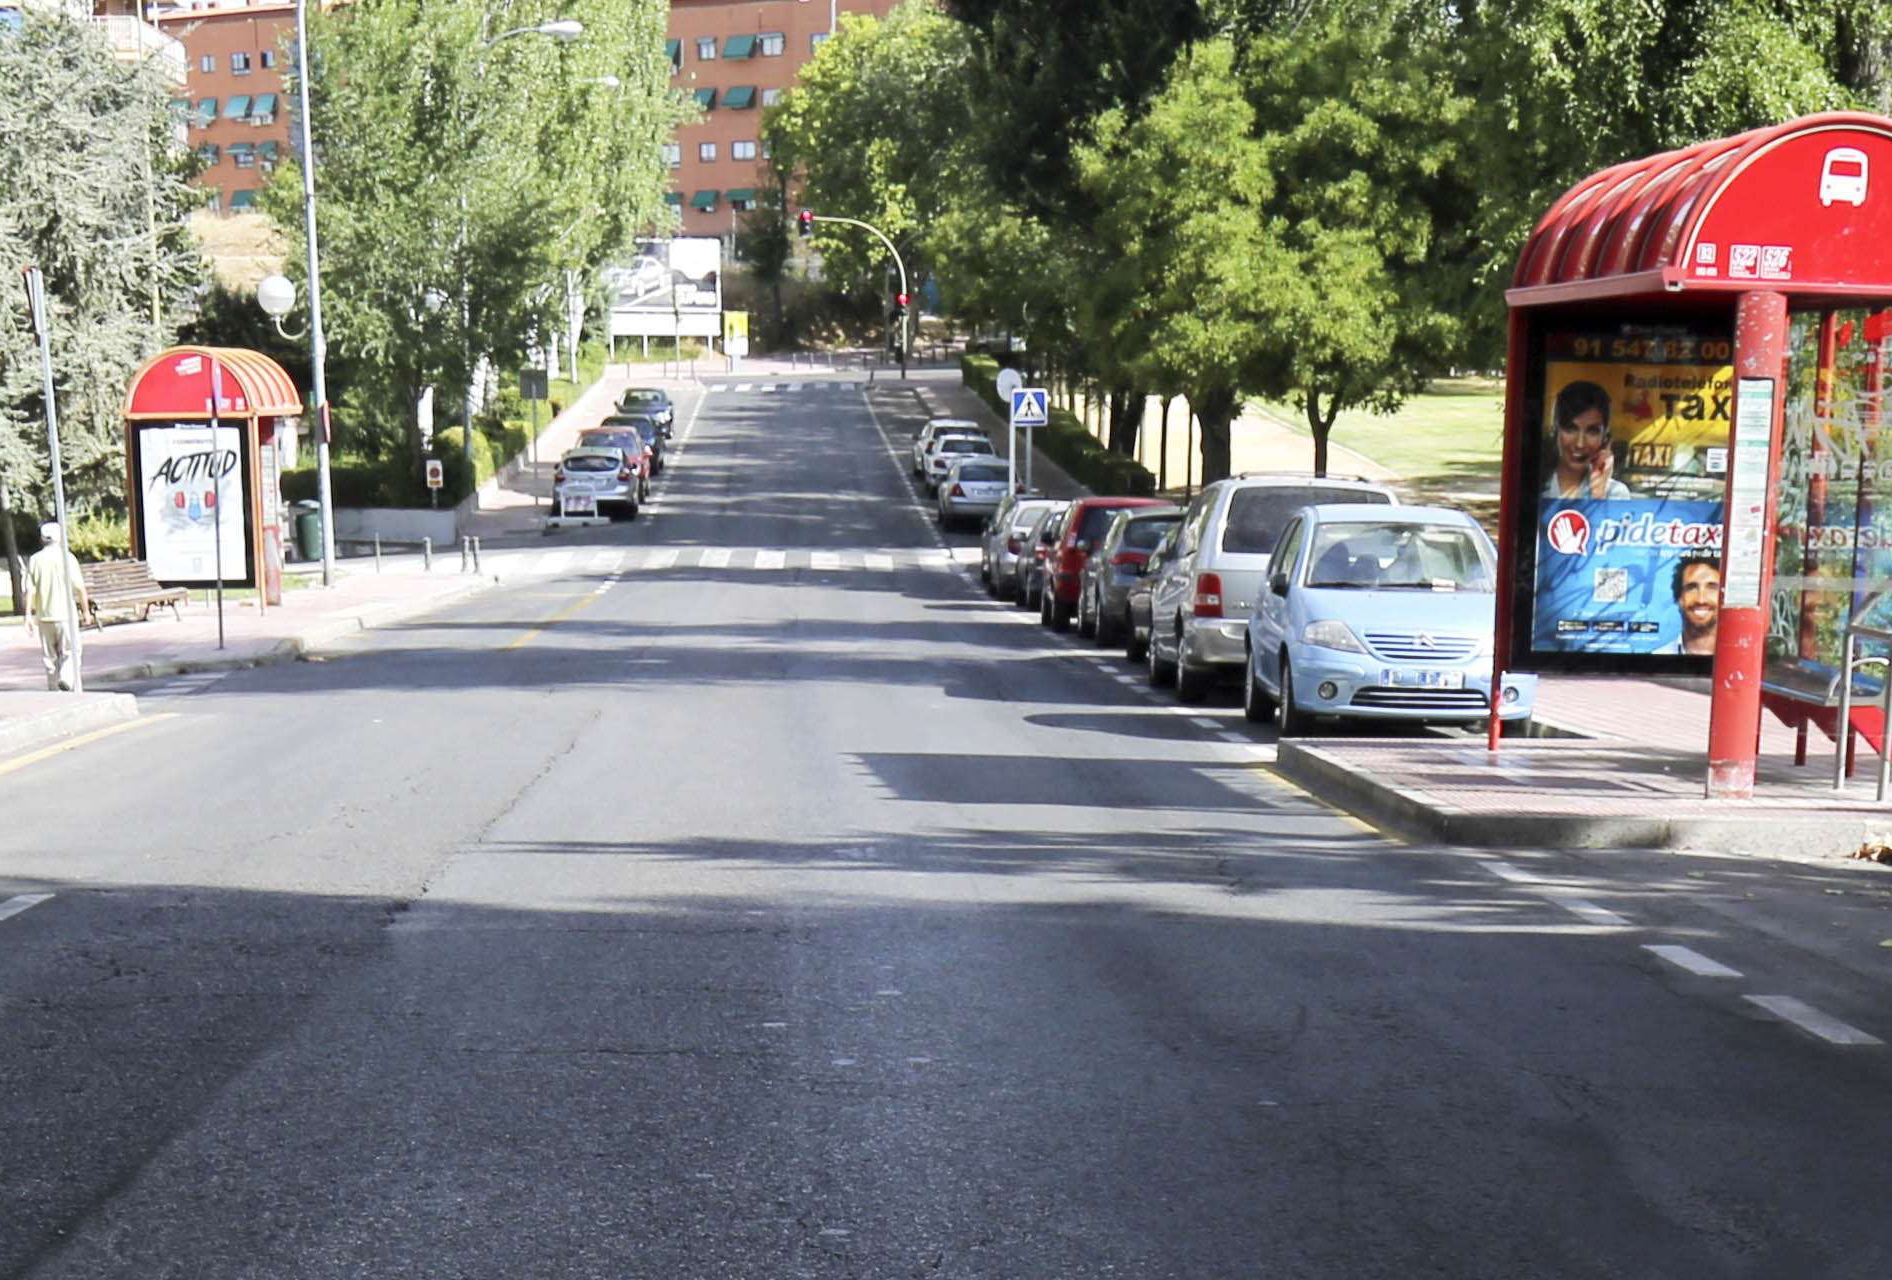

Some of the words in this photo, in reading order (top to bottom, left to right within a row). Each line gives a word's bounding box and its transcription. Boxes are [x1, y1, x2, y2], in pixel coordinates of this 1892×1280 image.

[1733, 247, 1758, 267] 522
[1764, 248, 1789, 269] 526
[1573, 337, 1602, 357] 91
[1612, 339, 1656, 358] 547
[1701, 341, 1730, 361] 00
[1632, 443, 1673, 467] TAXI
[149, 449, 237, 493] ACTITUD
